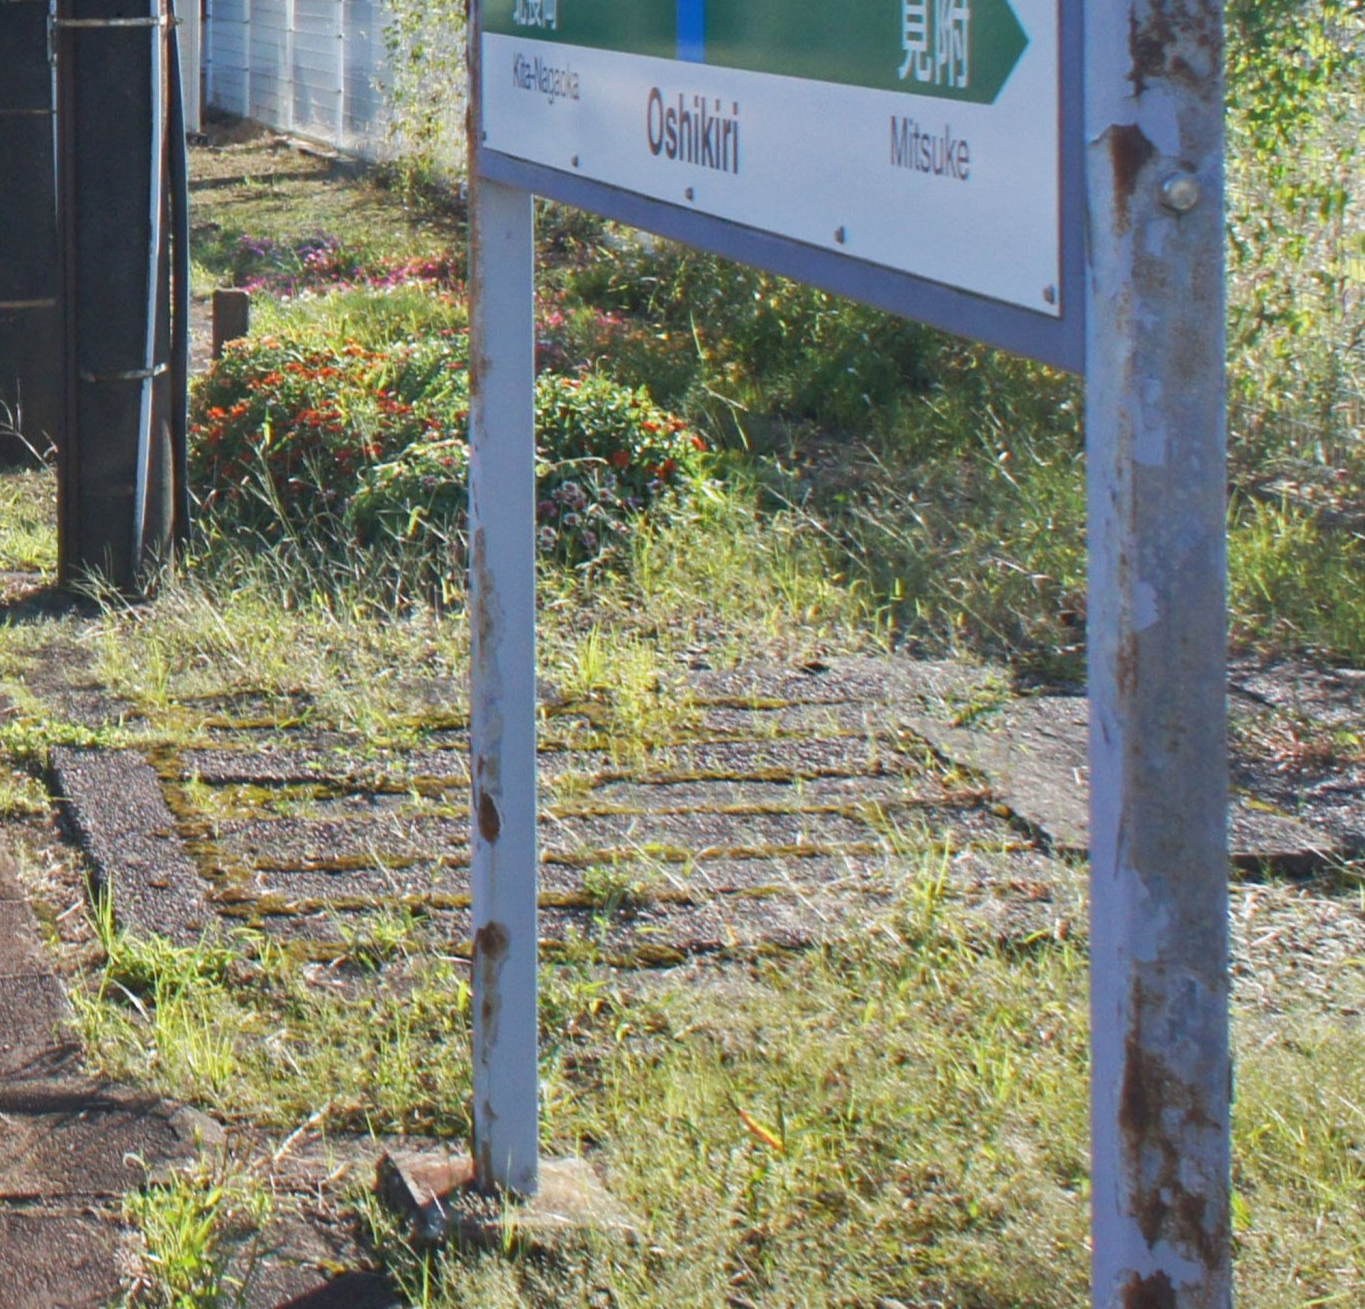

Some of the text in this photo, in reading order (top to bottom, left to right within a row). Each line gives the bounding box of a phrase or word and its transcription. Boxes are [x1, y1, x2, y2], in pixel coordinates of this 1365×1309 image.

[513, 52, 580, 105] Kita-Nagaoka
[647, 86, 739, 175] Oshikiri
[889, 115, 970, 181] Mitsuke
